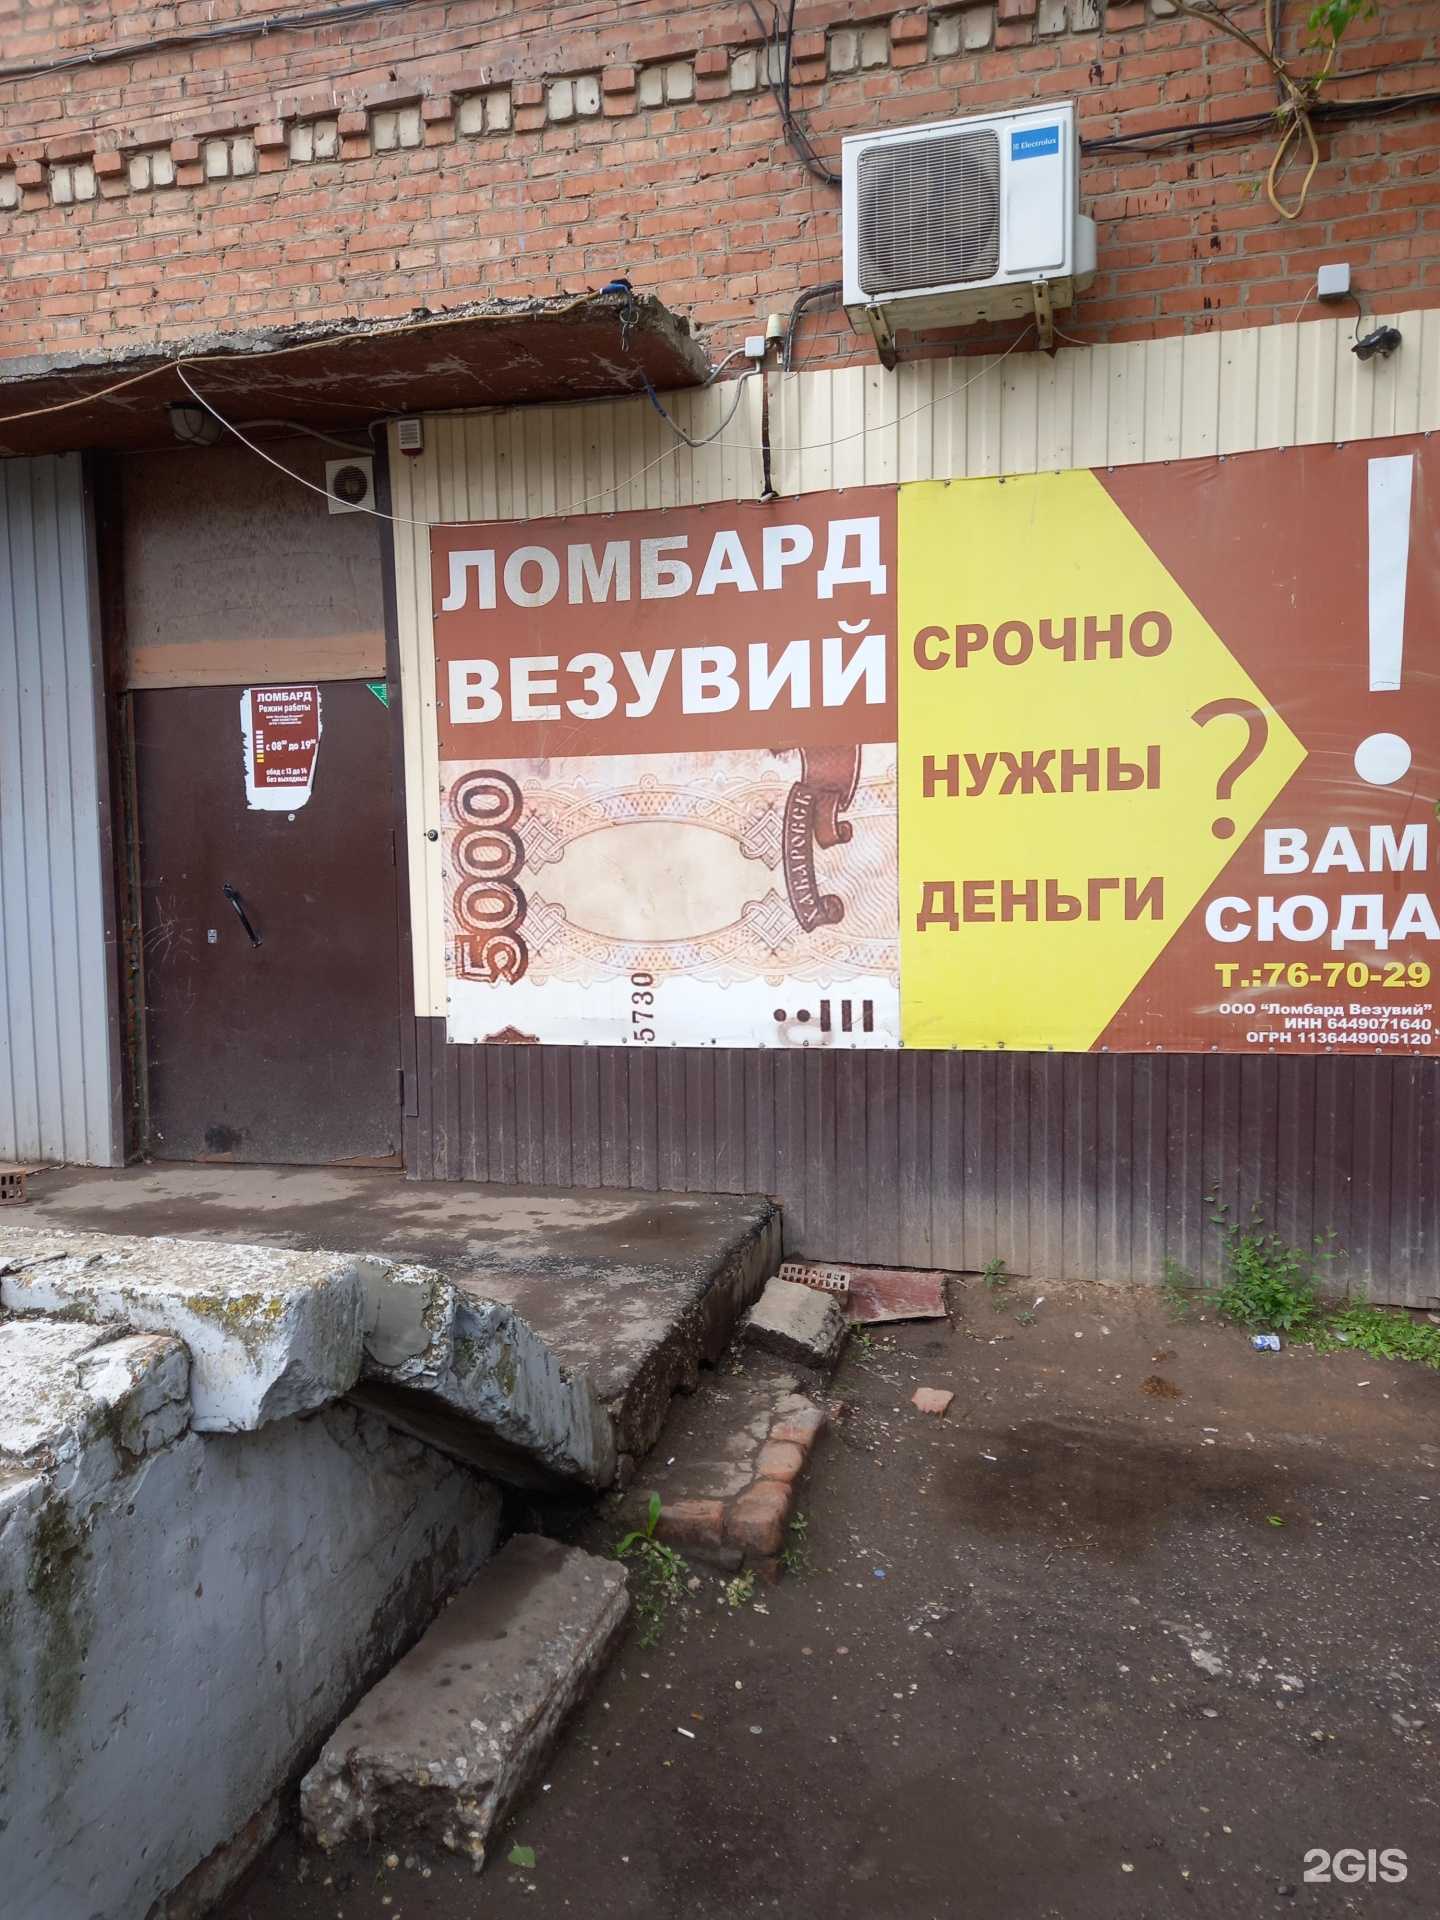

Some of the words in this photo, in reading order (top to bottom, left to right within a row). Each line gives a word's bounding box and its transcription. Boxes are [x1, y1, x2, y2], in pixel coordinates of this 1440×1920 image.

[1021, 137, 1057, 149] Electrolux
[441, 516, 887, 612] ЛОМБАРД
[913, 610, 1172, 671] СРОЧНО
[256, 691, 312, 703] ЛОМБАРД
[447, 619, 886, 724] ВЕЗУВИЙ
[259, 704, 283, 713] Режим
[284, 703, 311, 714] работы
[288, 743, 299, 752] до
[922, 744, 1161, 798] НУЖНЫ
[1263, 823, 1428, 875] ВАМ
[449, 769, 529, 986] 5000
[916, 876, 1165, 932] ДЕНЬГИ
[1205, 893, 1440, 951] СЮДА
[630, 972, 656, 1043] 5730
[1219, 1003, 1256, 1015] ООО
[1284, 1018, 1322, 1029] ИНН
[1327, 1018, 1432, 1030] 6449071640
[1246, 1031, 1292, 1043] ОГРН
[1297, 1032, 1432, 1045] 1136449005120
